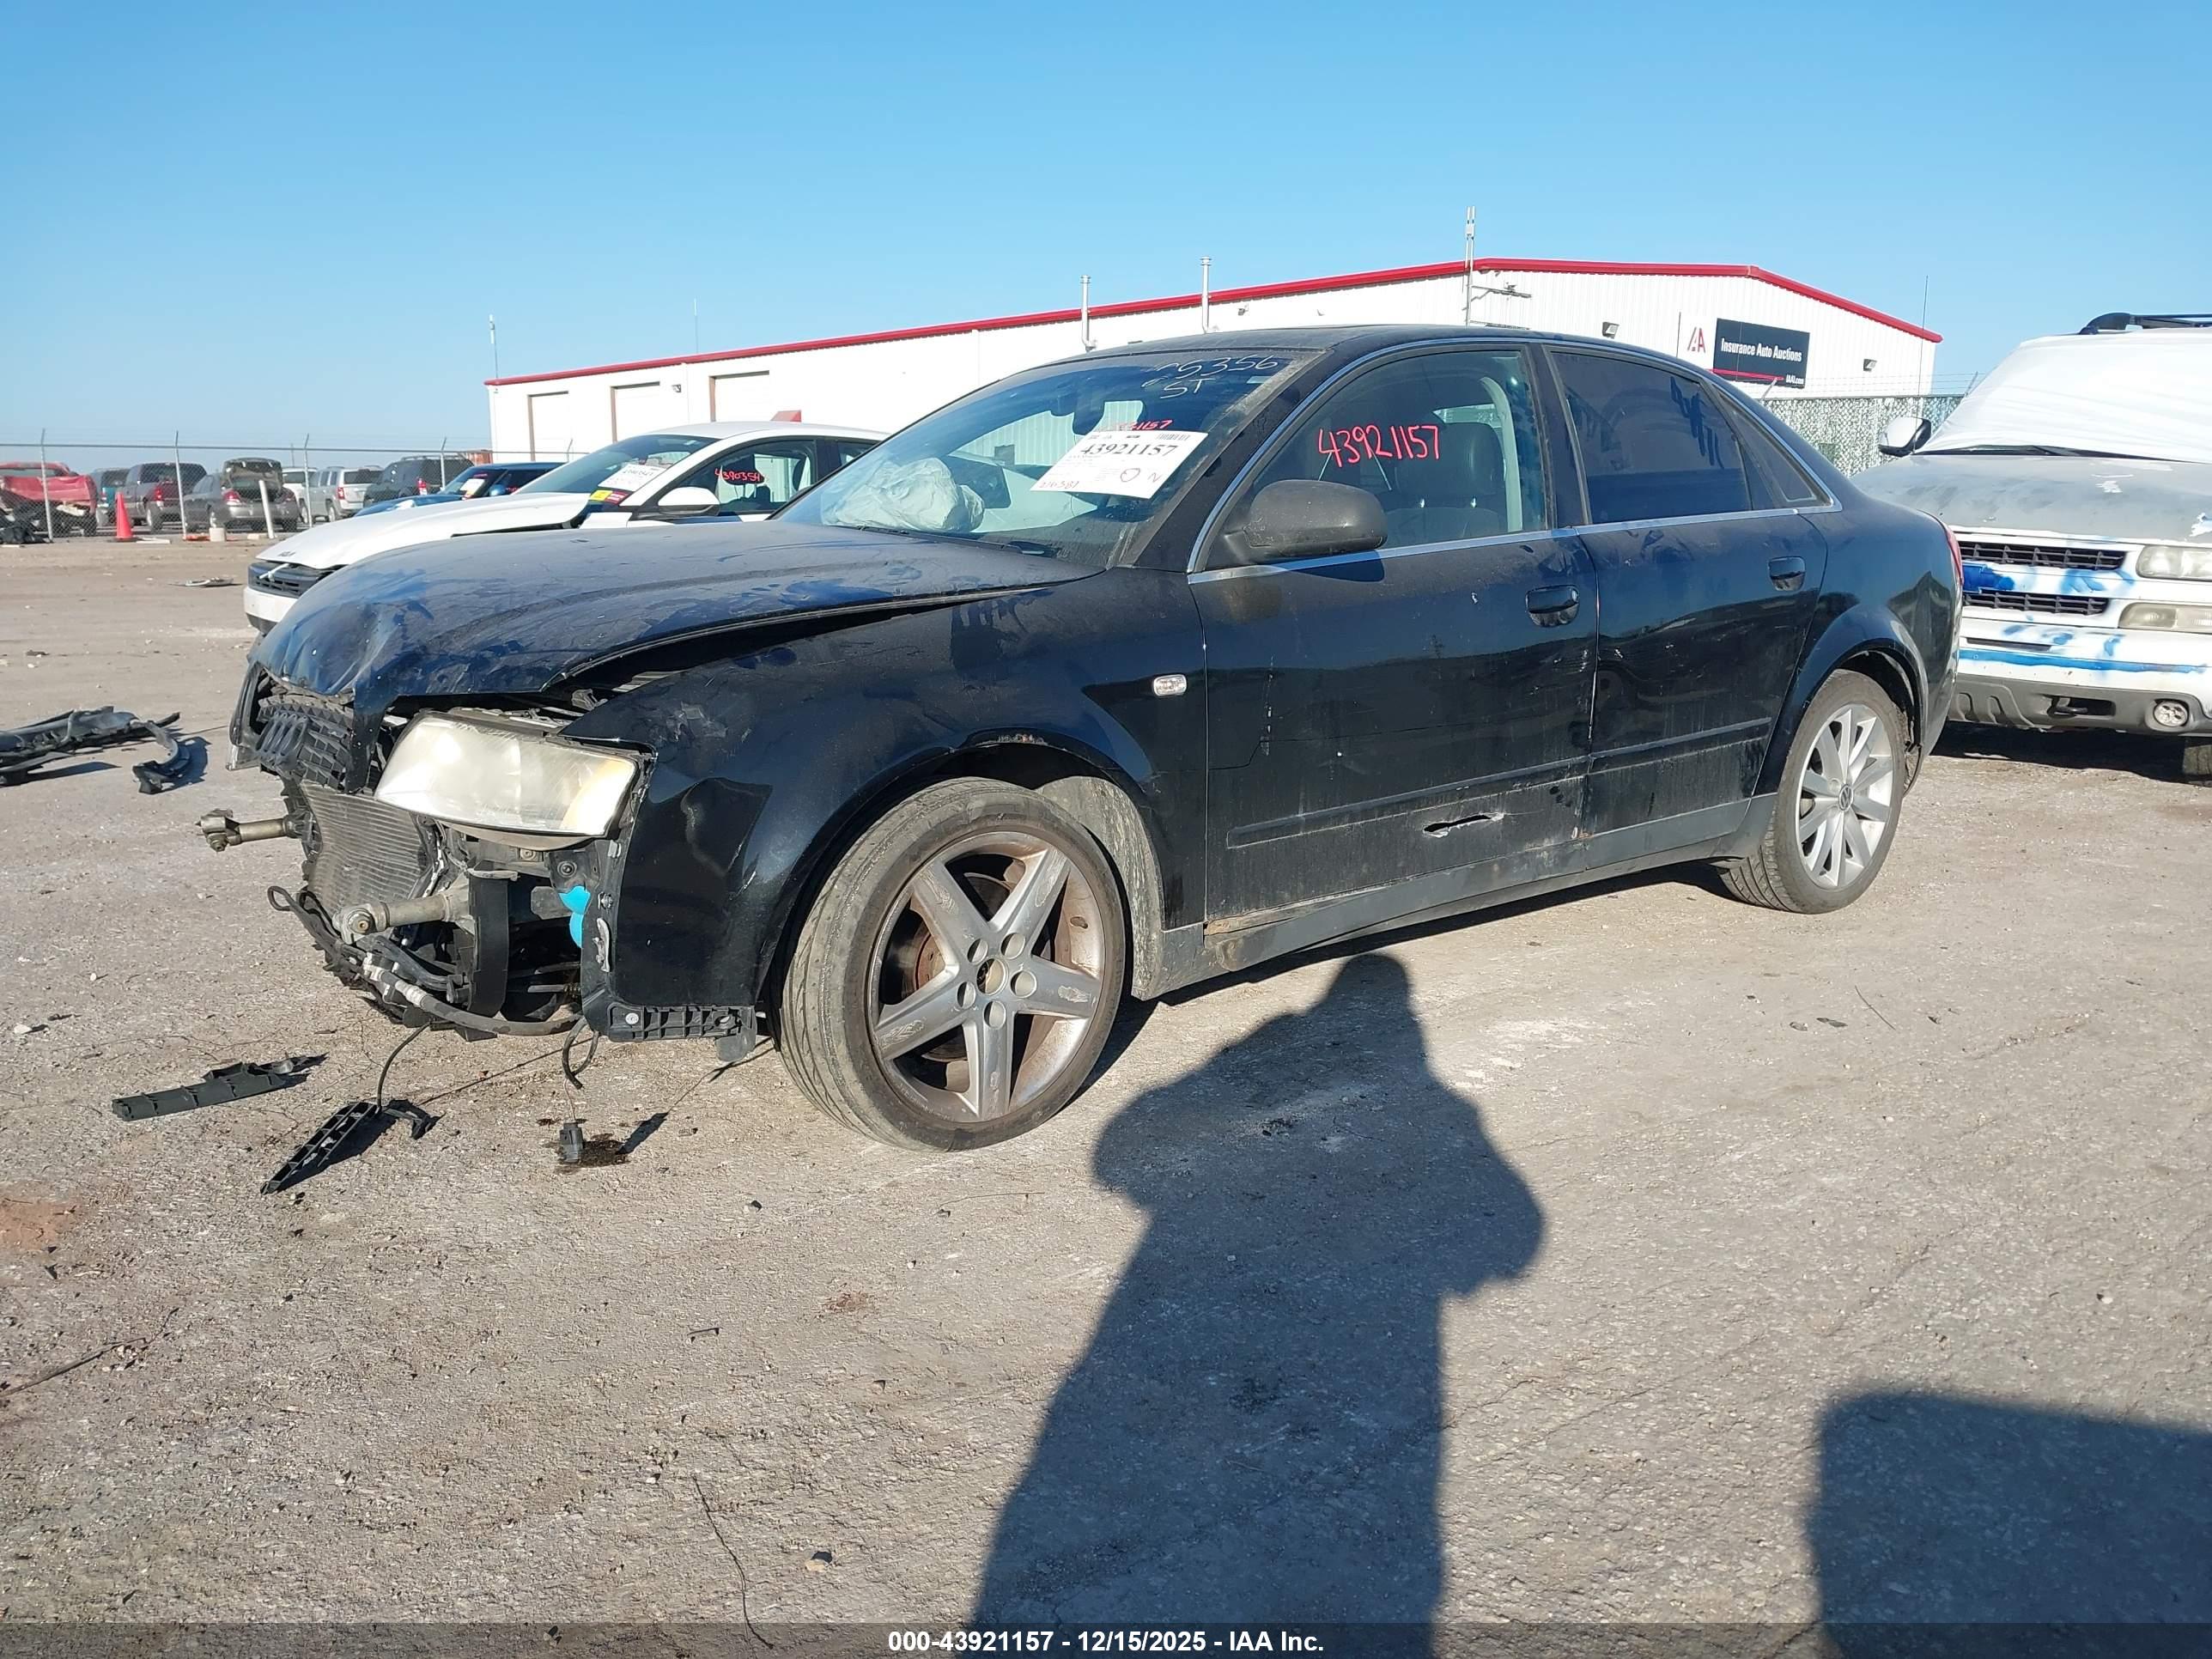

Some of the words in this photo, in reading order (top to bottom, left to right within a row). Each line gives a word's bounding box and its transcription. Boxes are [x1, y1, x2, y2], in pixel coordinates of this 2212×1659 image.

[1721, 337, 1756, 355] Insurance
[1756, 343, 1772, 358] Auto
[1772, 345, 1802, 362] Auctions
[1080, 443, 1180, 457] 43921157
[1318, 425, 1440, 468] 43921157
